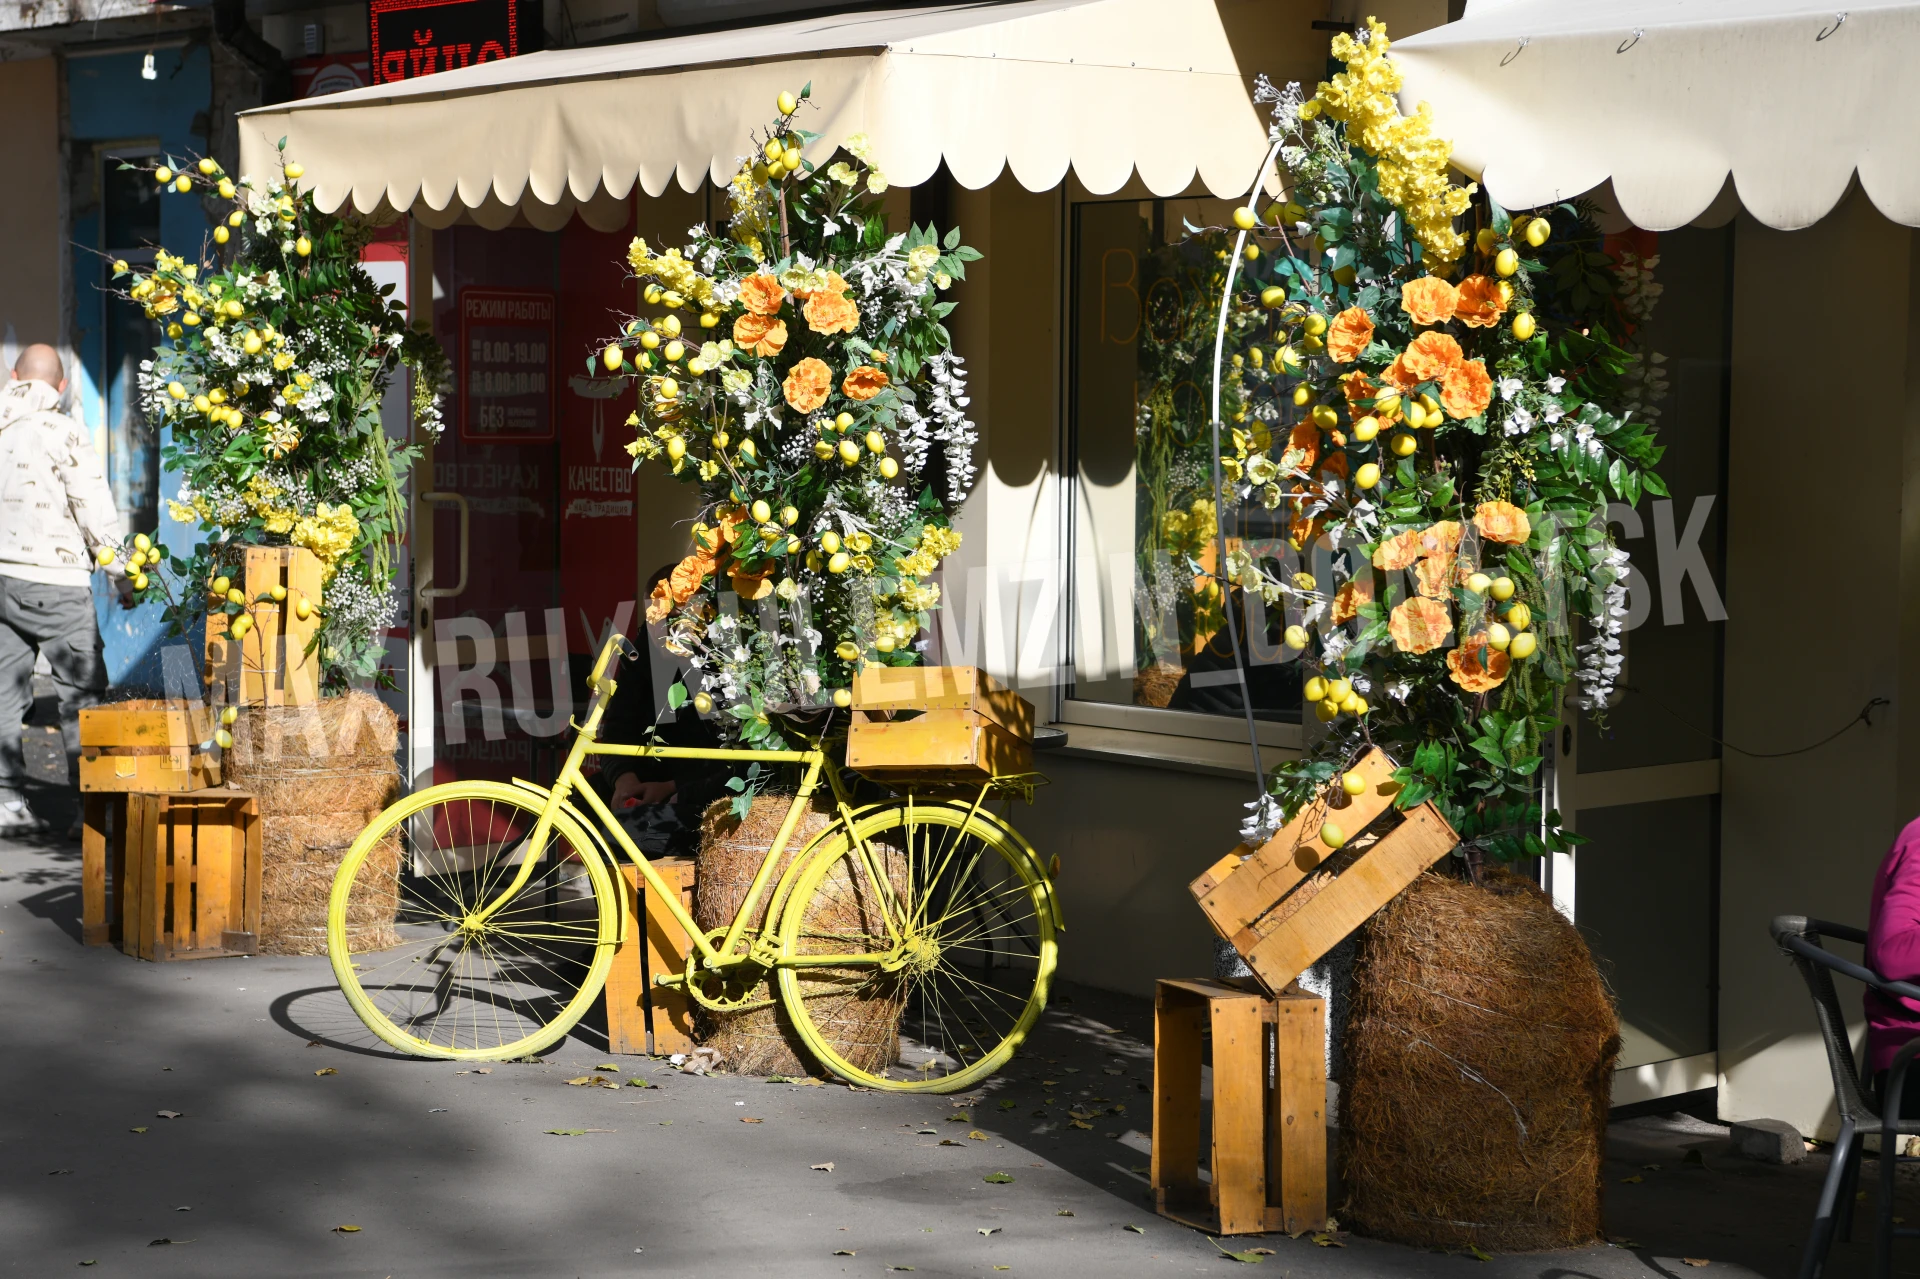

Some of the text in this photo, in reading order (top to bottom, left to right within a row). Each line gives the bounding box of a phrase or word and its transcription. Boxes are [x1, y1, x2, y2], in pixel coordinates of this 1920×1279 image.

[466, 298, 552, 320] РЕЖИМ РАБОТЫ
[483, 341, 546, 364] 8.00-19.00
[484, 371, 546, 394] 8.00-18.00
[480, 405, 505, 428] БЕЗ
[568, 465, 632, 494] КАЧЕСТВО
[574, 501, 629, 515] НАША ТРАДИЦИЯ
